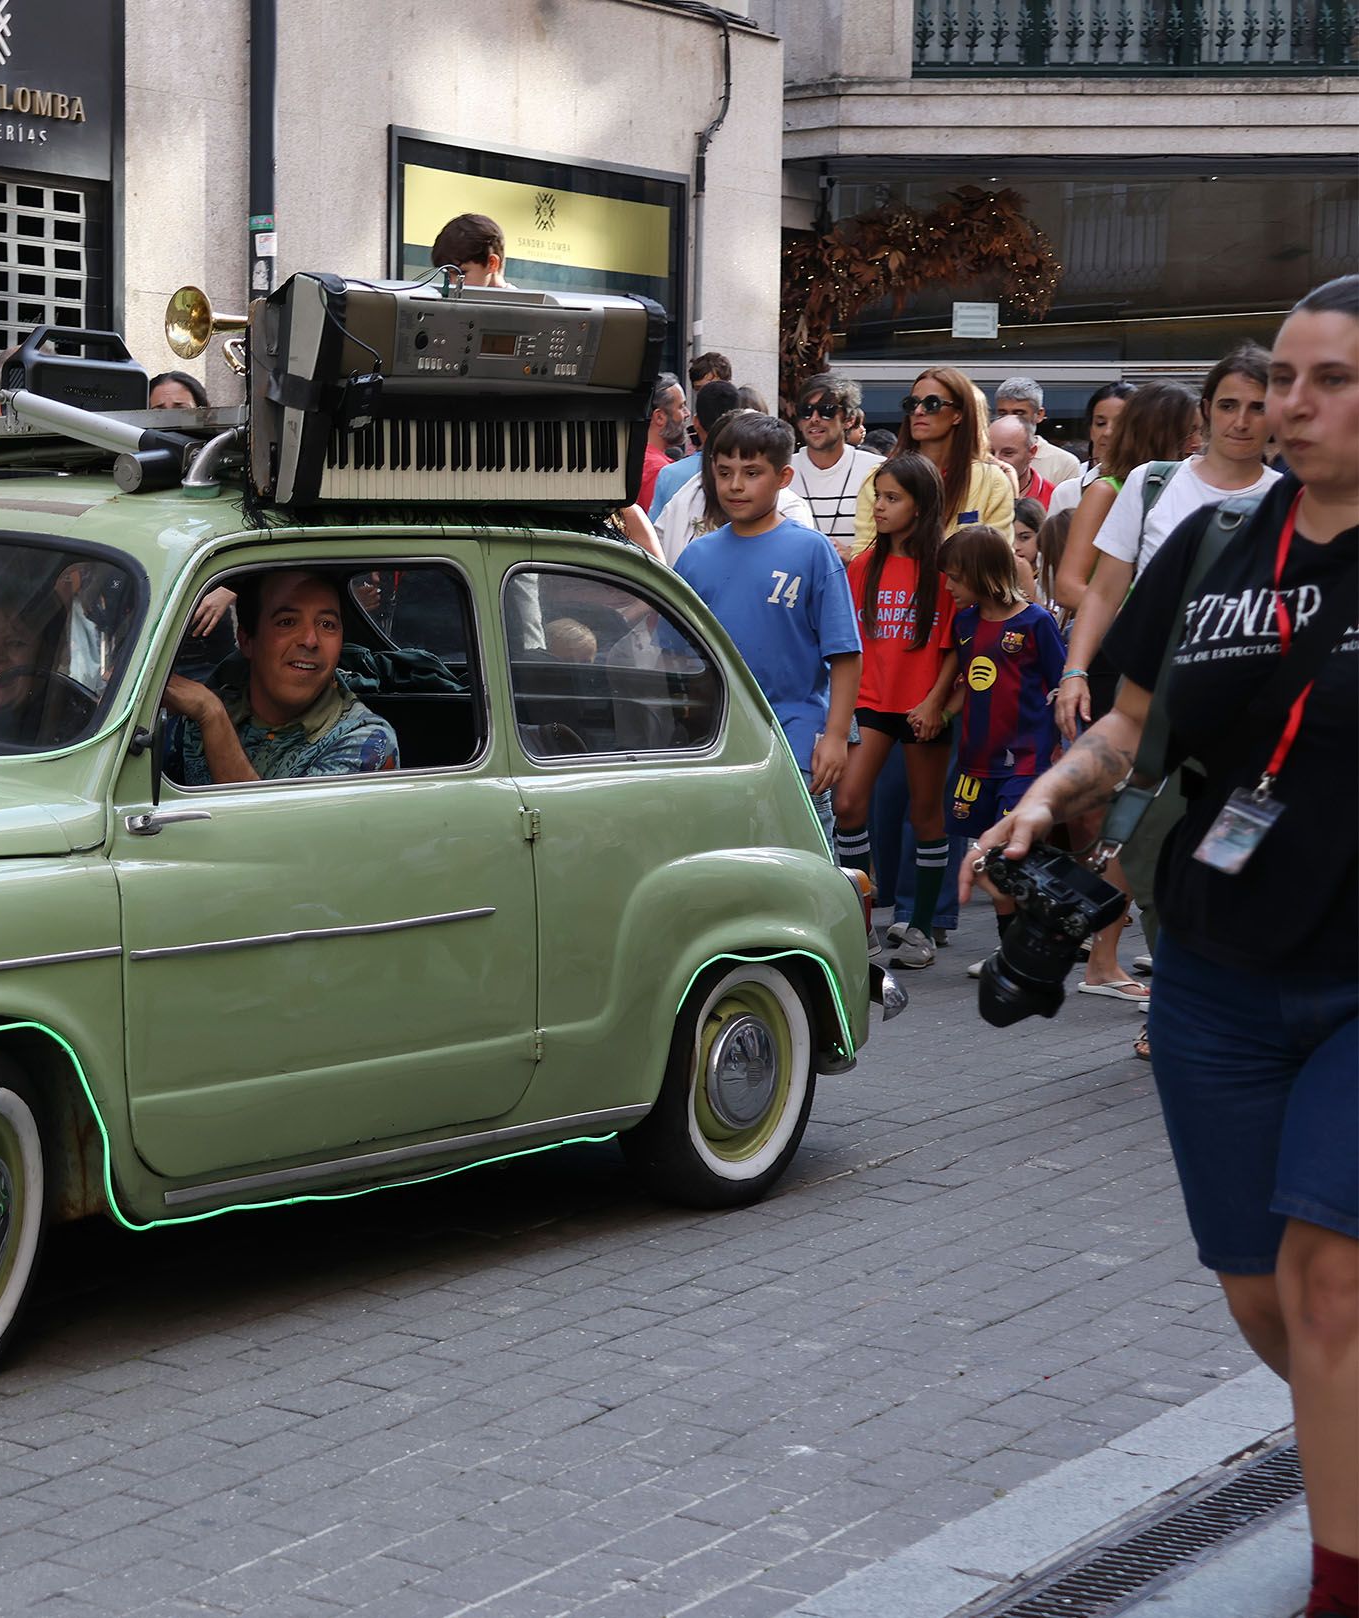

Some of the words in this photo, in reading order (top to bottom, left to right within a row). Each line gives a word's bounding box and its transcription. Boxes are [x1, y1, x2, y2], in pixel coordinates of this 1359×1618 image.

[767, 570, 802, 608] 74
[894, 590, 906, 605] IS
[874, 624, 902, 639] ALTY
[953, 773, 982, 802] 10
